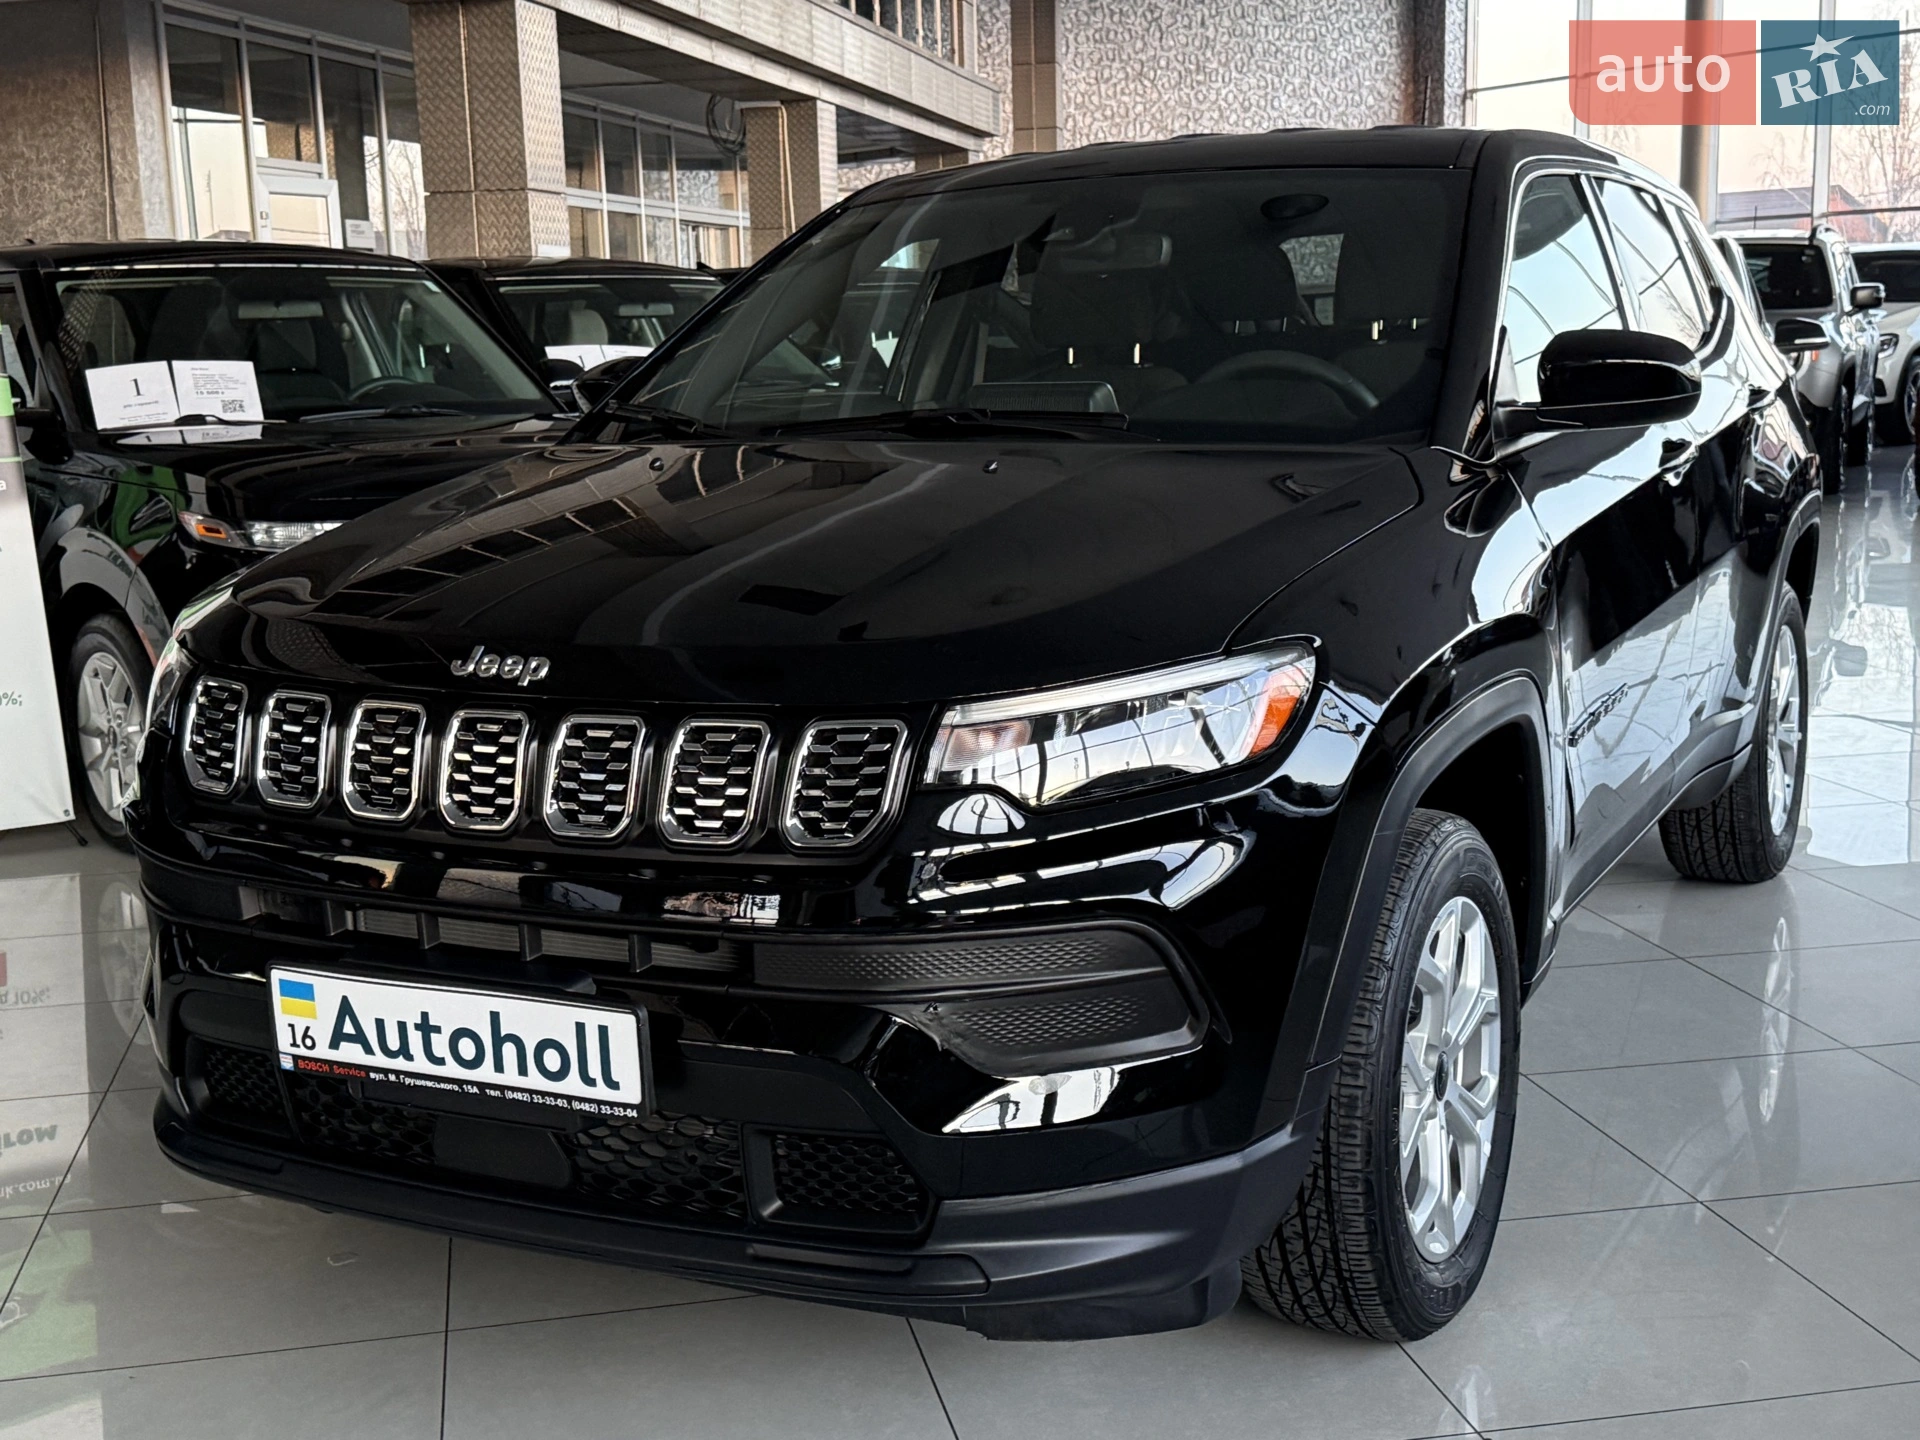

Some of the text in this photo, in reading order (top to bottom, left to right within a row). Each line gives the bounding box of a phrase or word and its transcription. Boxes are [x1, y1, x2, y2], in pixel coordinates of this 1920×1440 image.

[130, 378, 144, 397] 1
[451, 646, 551, 687] Jeep
[288, 1024, 316, 1051] 16
[329, 996, 621, 1091] Autoholl
[298, 1060, 330, 1072] BOSCH
[333, 1065, 366, 1077] Service
